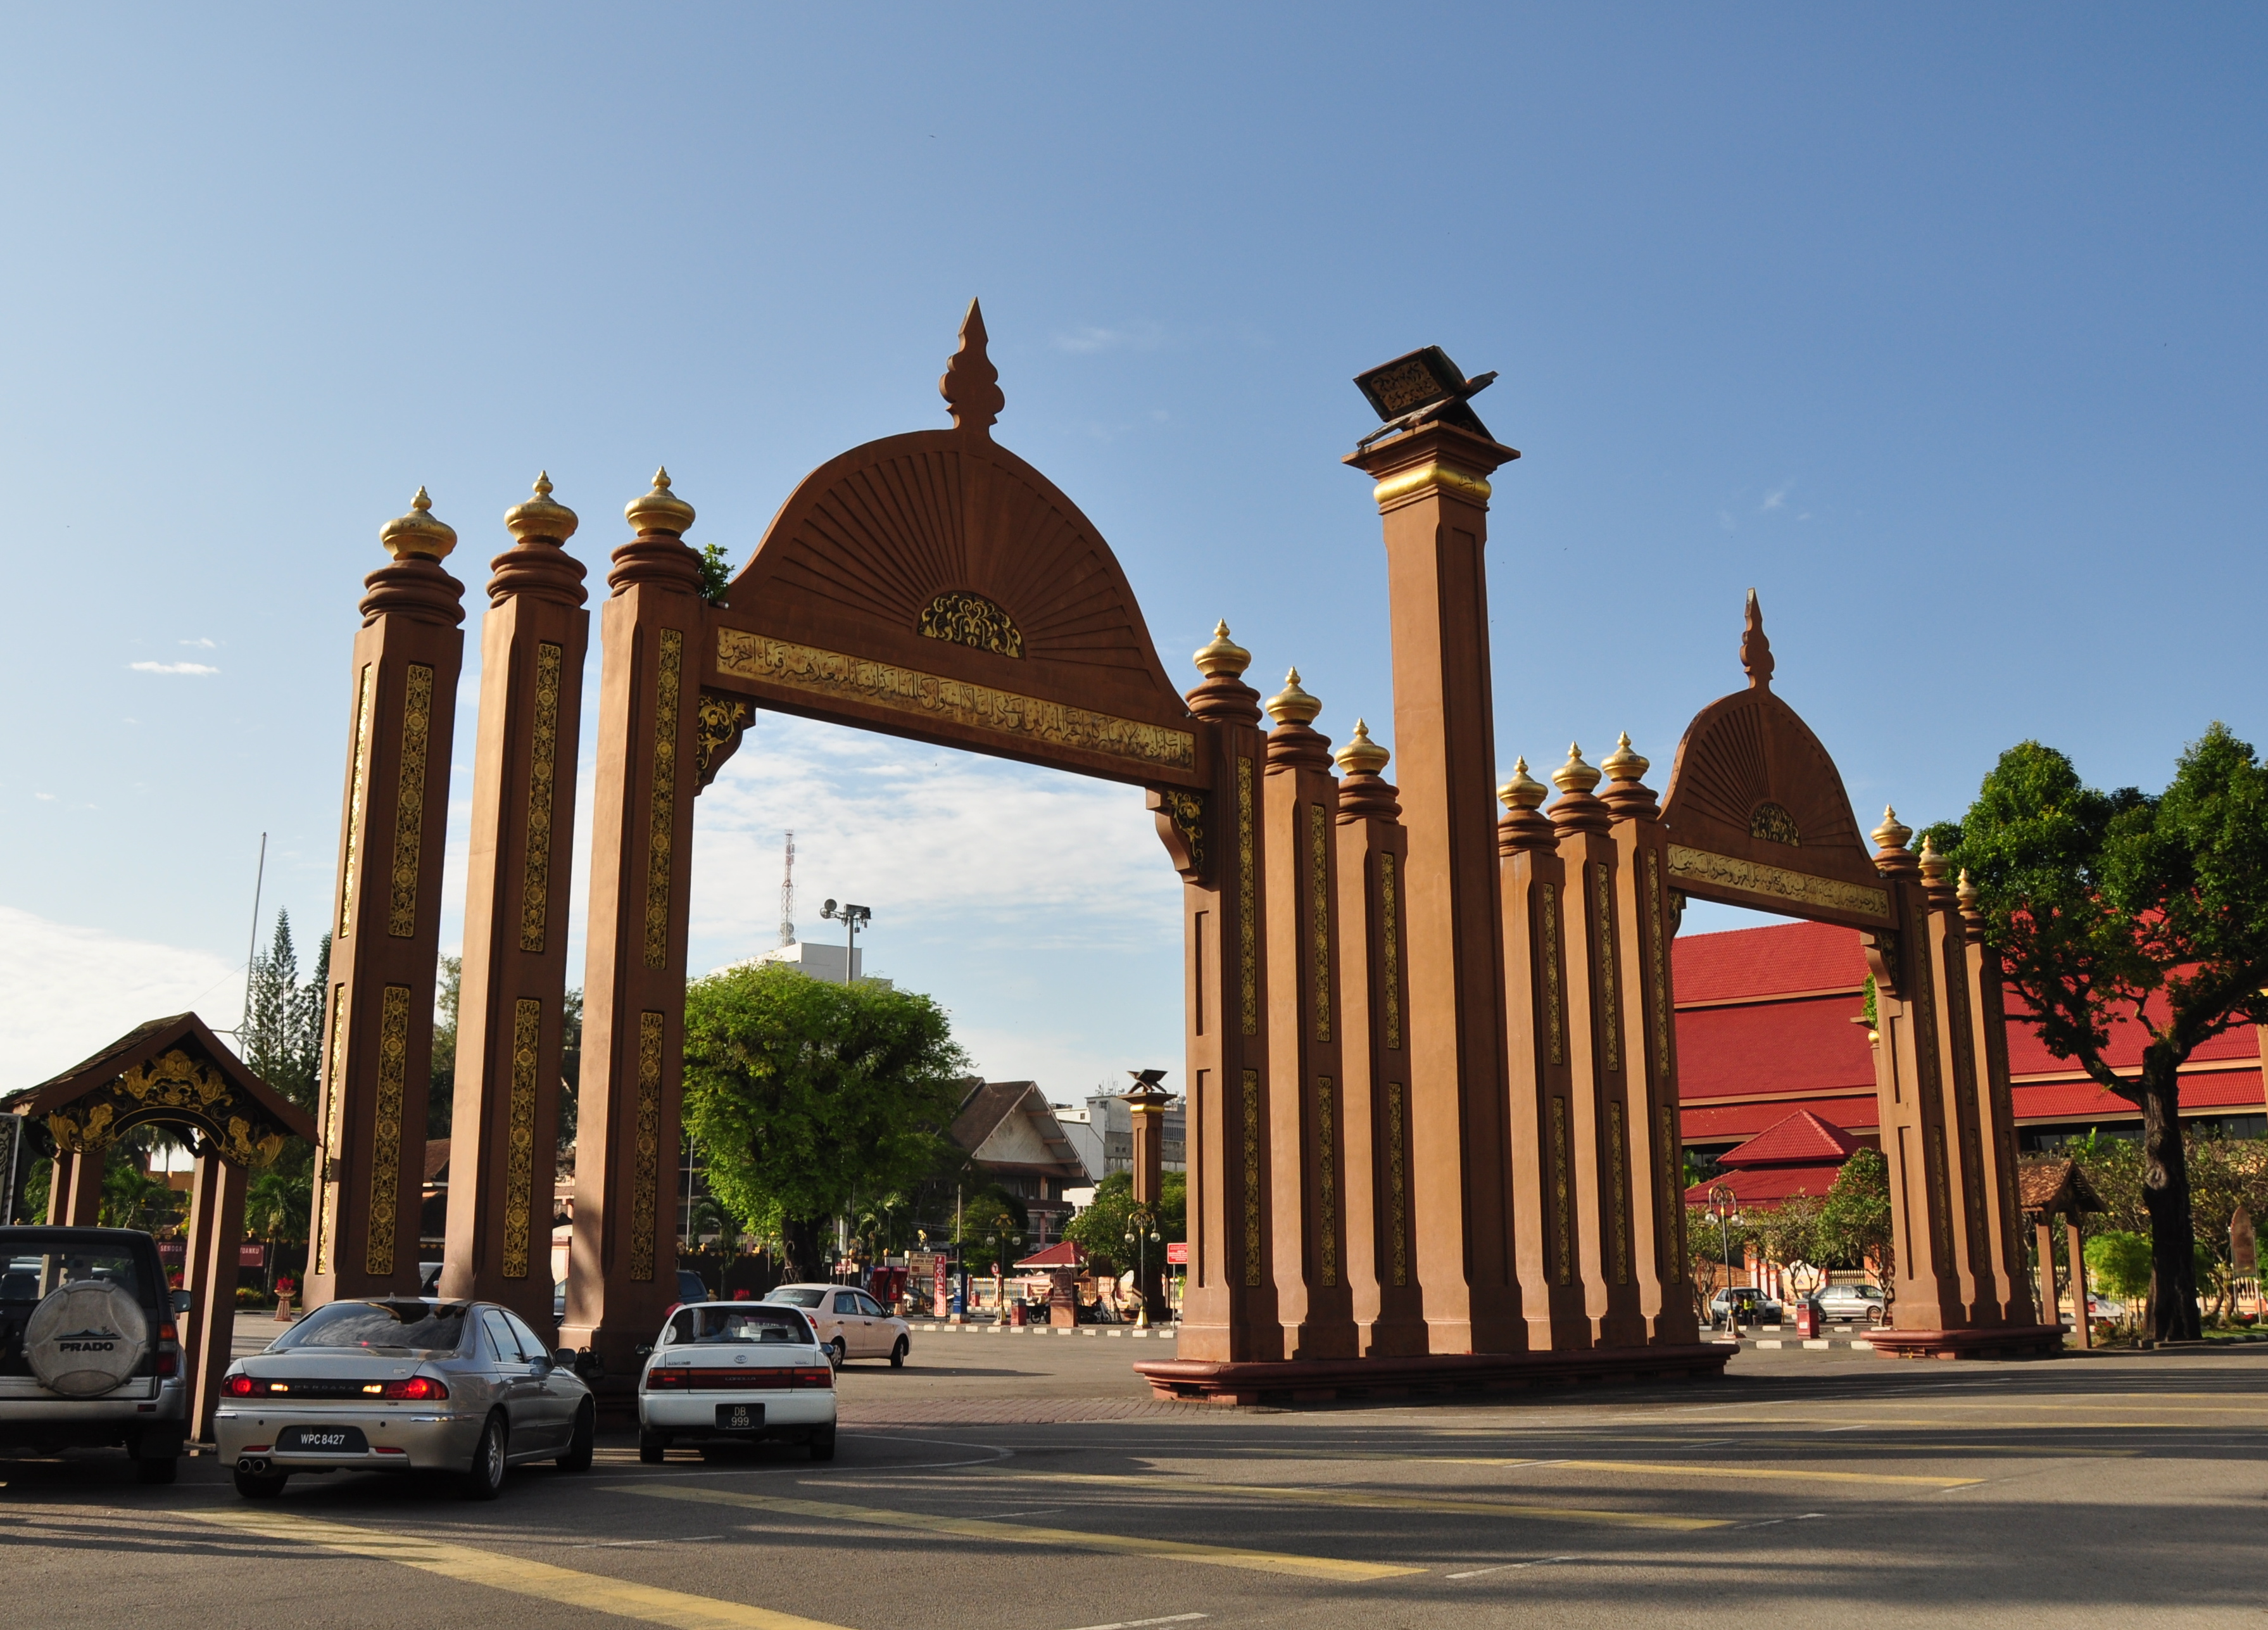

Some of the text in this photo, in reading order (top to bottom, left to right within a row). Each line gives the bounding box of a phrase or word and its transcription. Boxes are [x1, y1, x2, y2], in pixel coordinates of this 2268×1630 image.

[60, 1342, 114, 1352] PRADO
[734, 1406, 747, 1417] DB
[731, 1417, 749, 1426] 999
